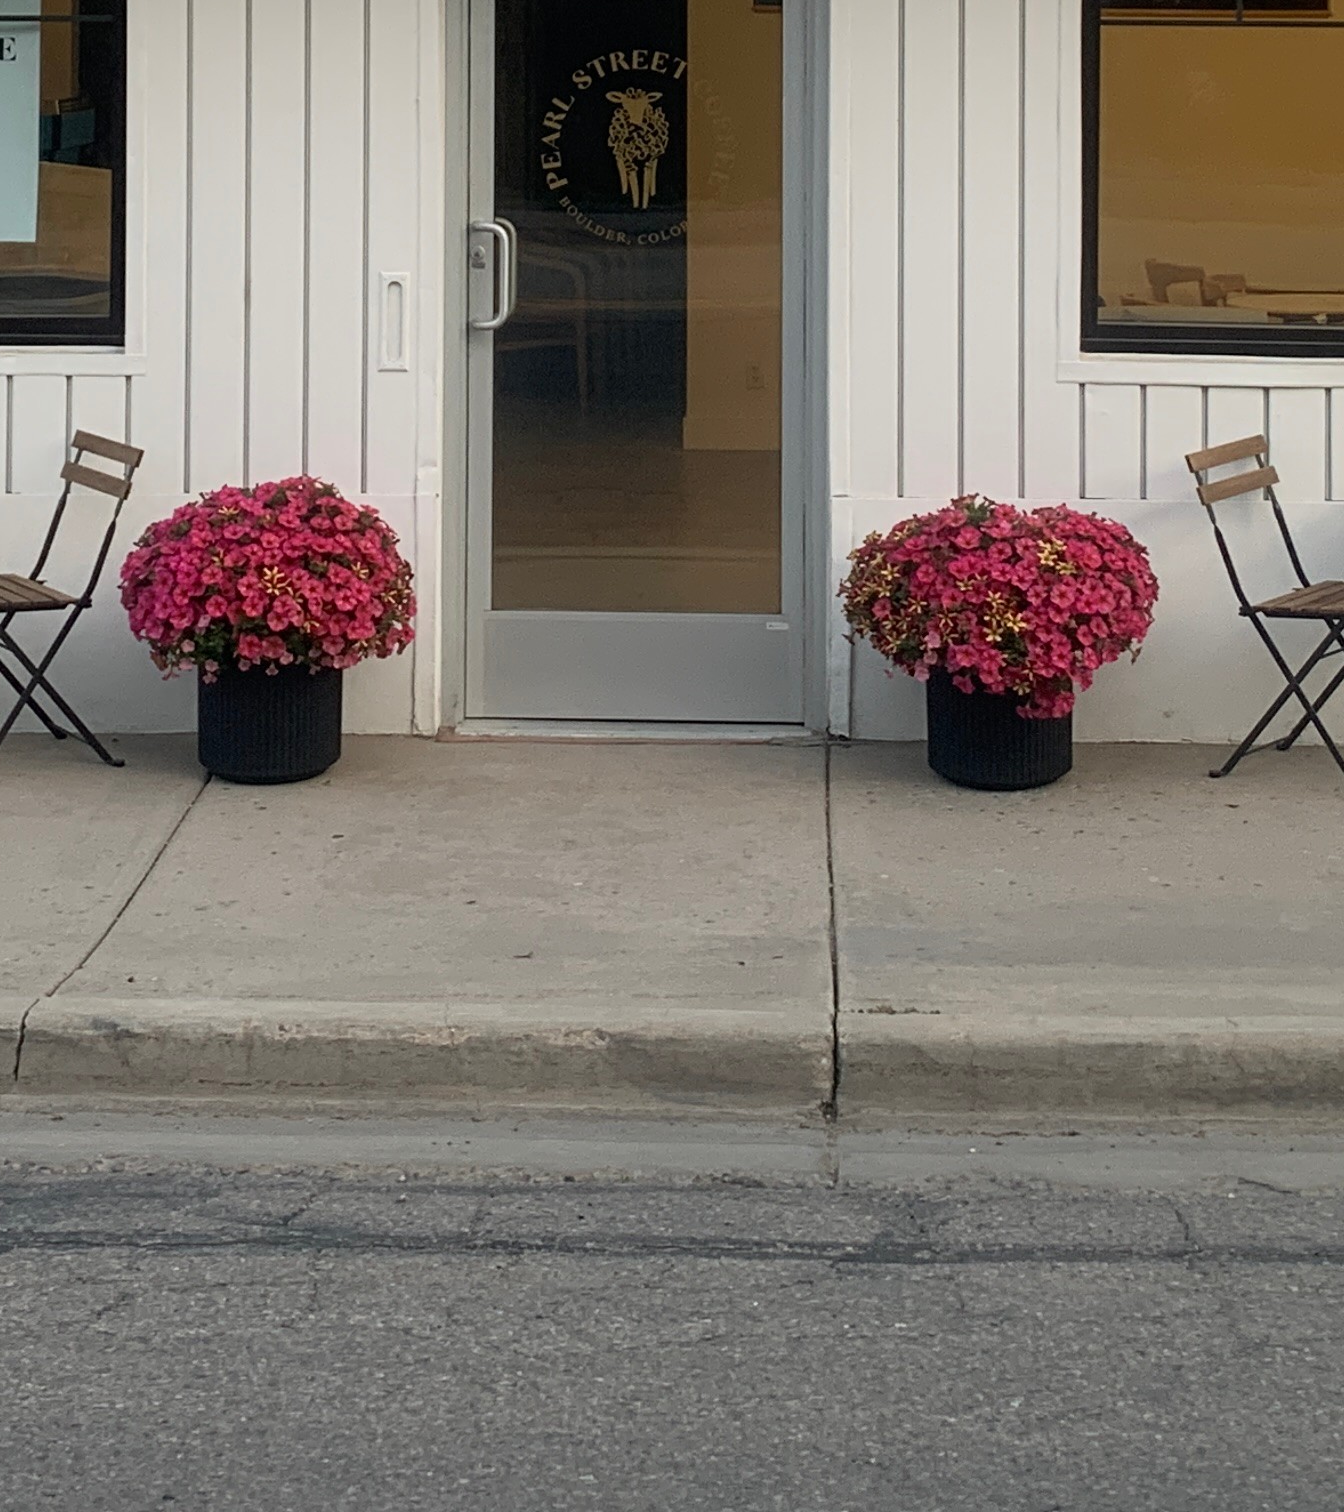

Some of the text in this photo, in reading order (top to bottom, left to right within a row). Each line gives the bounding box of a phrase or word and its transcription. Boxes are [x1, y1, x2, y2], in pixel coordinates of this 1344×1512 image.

[540, 95, 576, 190] PEARL
[571, 49, 689, 90] STREET
[559, 196, 632, 246] BOULDER,
